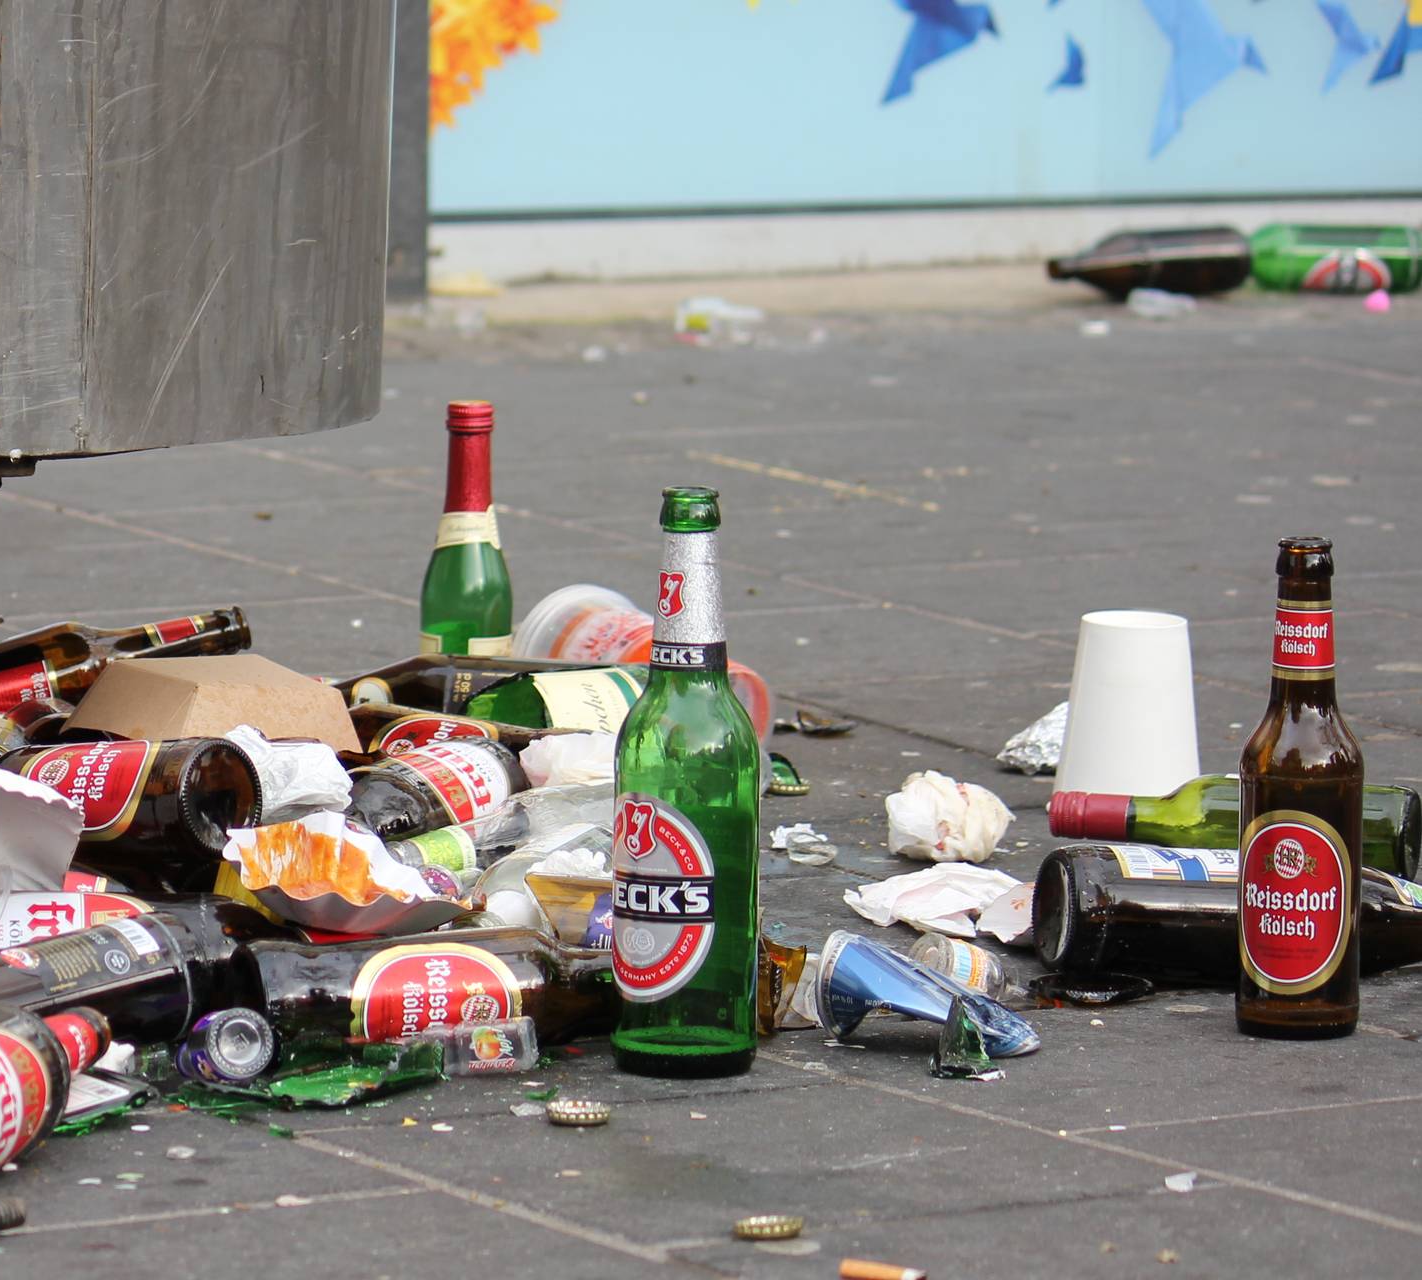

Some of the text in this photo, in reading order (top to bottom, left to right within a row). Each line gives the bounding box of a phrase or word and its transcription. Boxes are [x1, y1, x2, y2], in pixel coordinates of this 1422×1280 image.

[1275, 620, 1329, 639] Reissdorf
[652, 646, 704, 664] ECK'S
[1280, 641, 1315, 656] Kölsch
[68, 740, 113, 814] eissdor
[89, 749, 120, 801] Kölsch
[615, 881, 710, 914] ECK'S
[1246, 882, 1338, 911] Reissdorf
[9, 920, 23, 947] KÖL
[27, 902, 76, 942] fr
[1258, 913, 1315, 940] Kölsch
[619, 966, 657, 981] GERMANY
[424, 958, 452, 1029] Reiss
